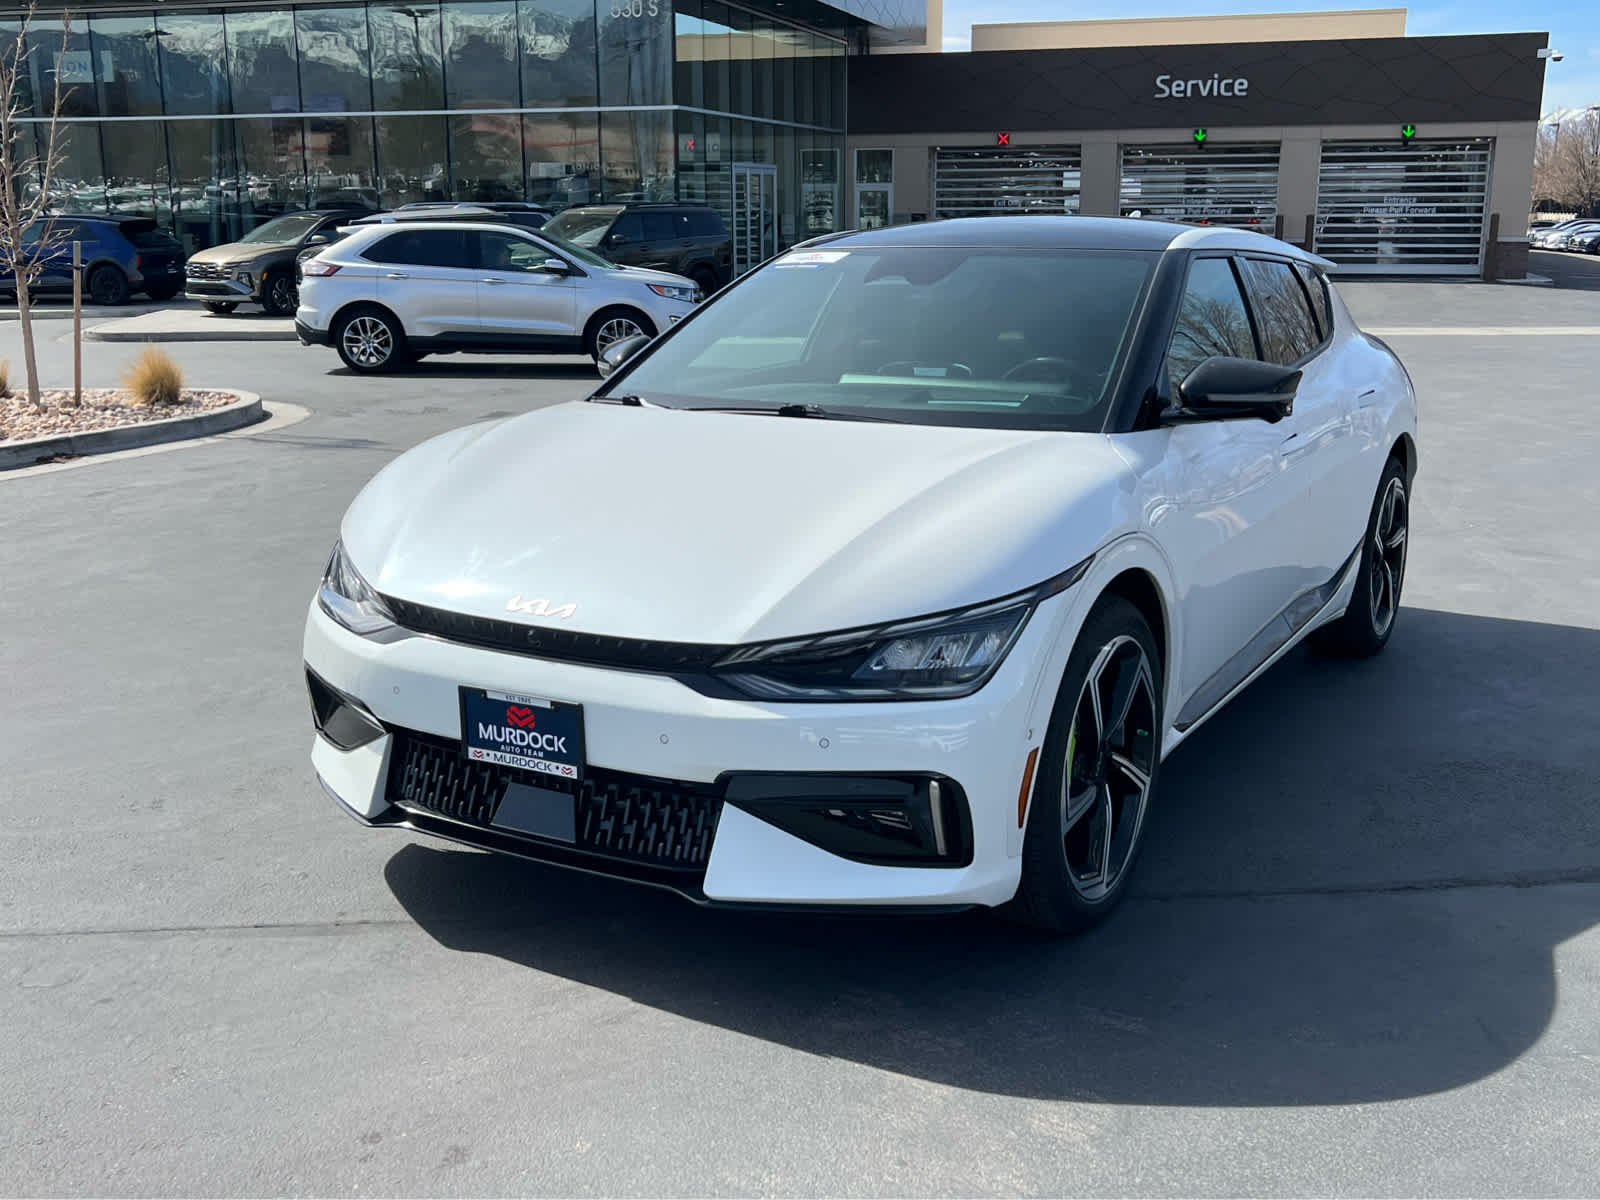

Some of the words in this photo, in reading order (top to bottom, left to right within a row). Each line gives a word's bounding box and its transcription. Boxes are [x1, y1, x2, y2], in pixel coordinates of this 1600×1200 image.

[1153, 73, 1249, 98] Service
[479, 721, 568, 754] MURDOCK
[493, 752, 554, 772] MURDOCK
[500, 744, 521, 753] AUTO
[523, 748, 544, 758] TEAM
